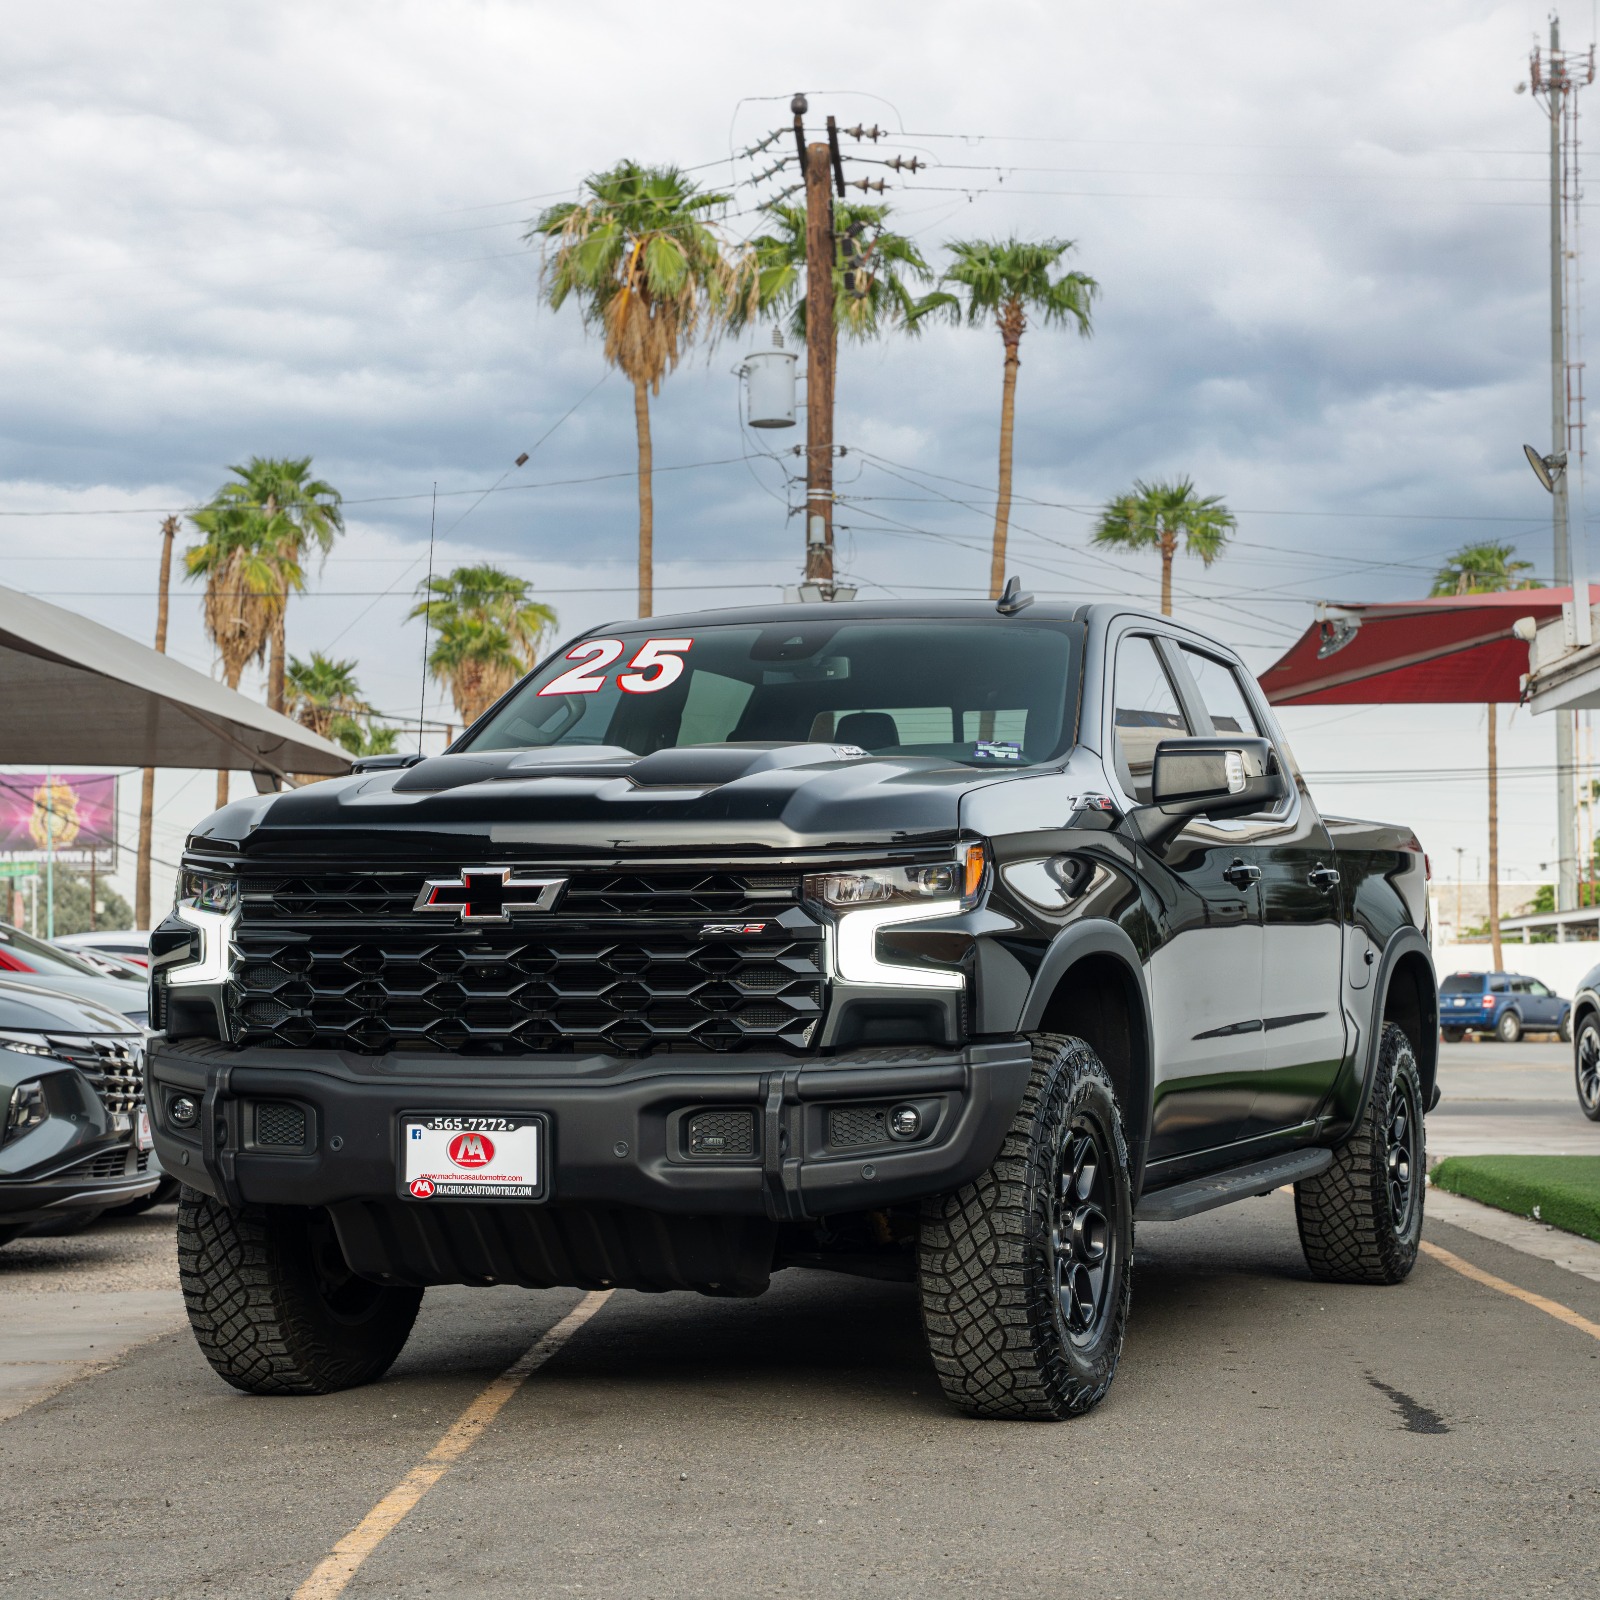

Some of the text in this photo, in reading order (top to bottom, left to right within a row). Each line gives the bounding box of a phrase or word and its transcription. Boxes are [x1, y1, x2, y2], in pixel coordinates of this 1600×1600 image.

[537, 638, 694, 696] 25
[434, 1118, 507, 1130] 565-7272
[420, 1173, 523, 1182] www.machucasautomotriz.com
[436, 1185, 532, 1196] MACHUCASAUTOMOTRIZ.COM
